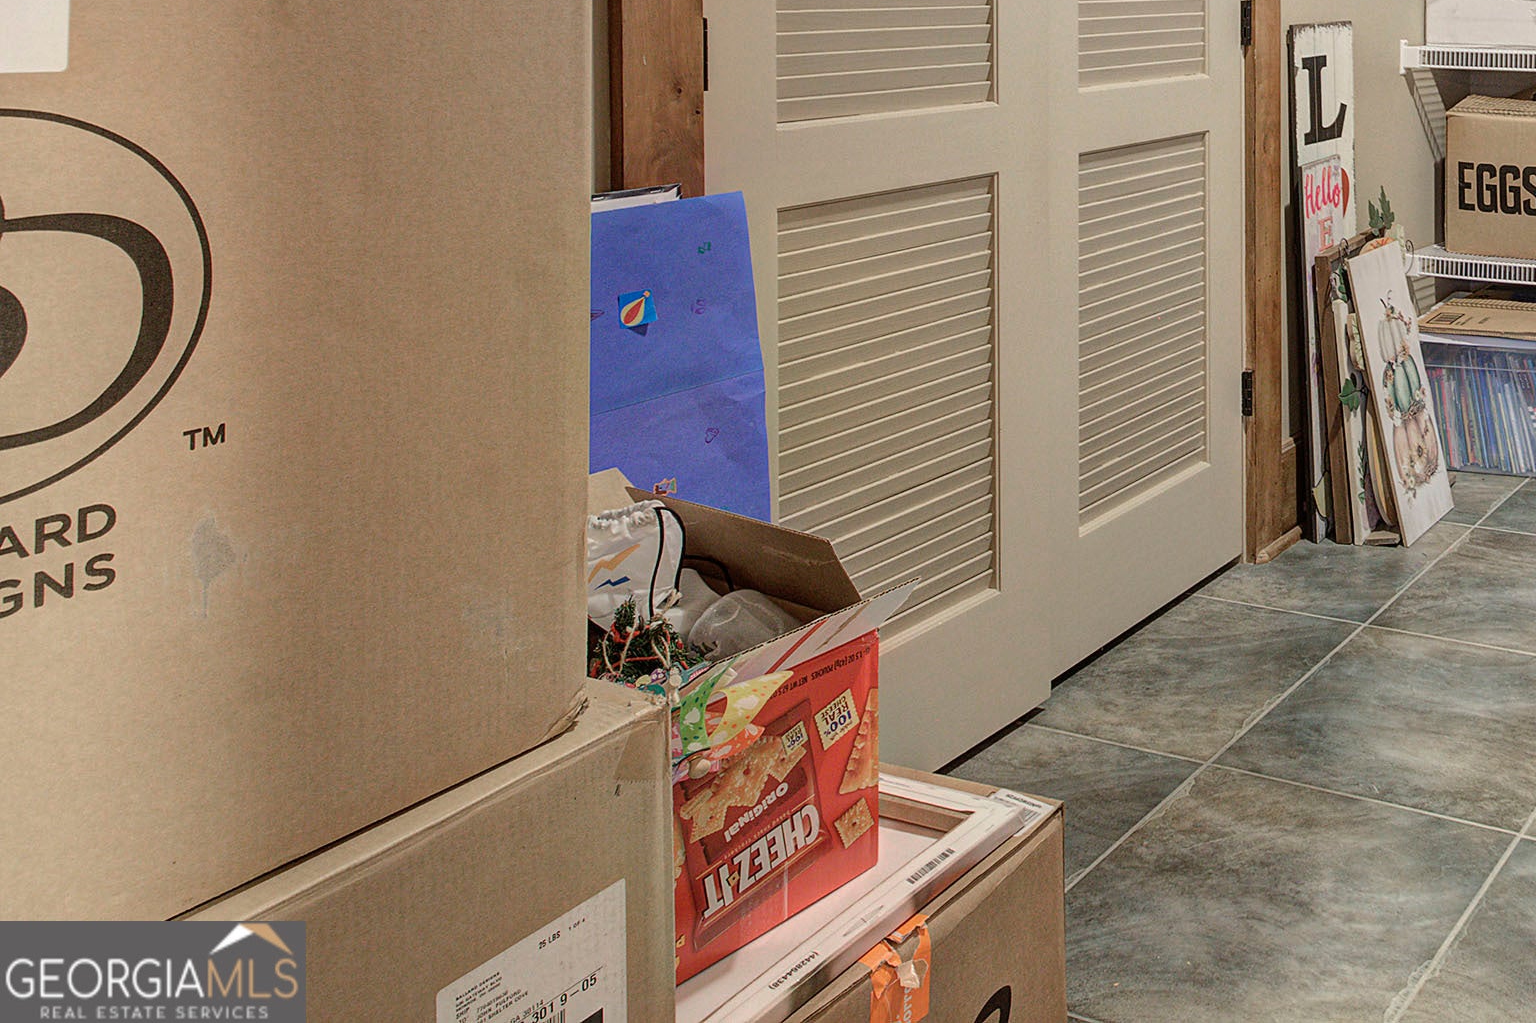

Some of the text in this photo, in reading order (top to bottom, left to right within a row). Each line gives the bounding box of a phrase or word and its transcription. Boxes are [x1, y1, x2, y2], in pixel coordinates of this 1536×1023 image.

[1300, 54, 1348, 145] L
[1304, 165, 1341, 219] Hello
[183, 423, 226, 451] TM
[821, 695, 846, 719] CHEESE
[822, 701, 850, 726] REAL
[823, 710, 853, 738] 100%
